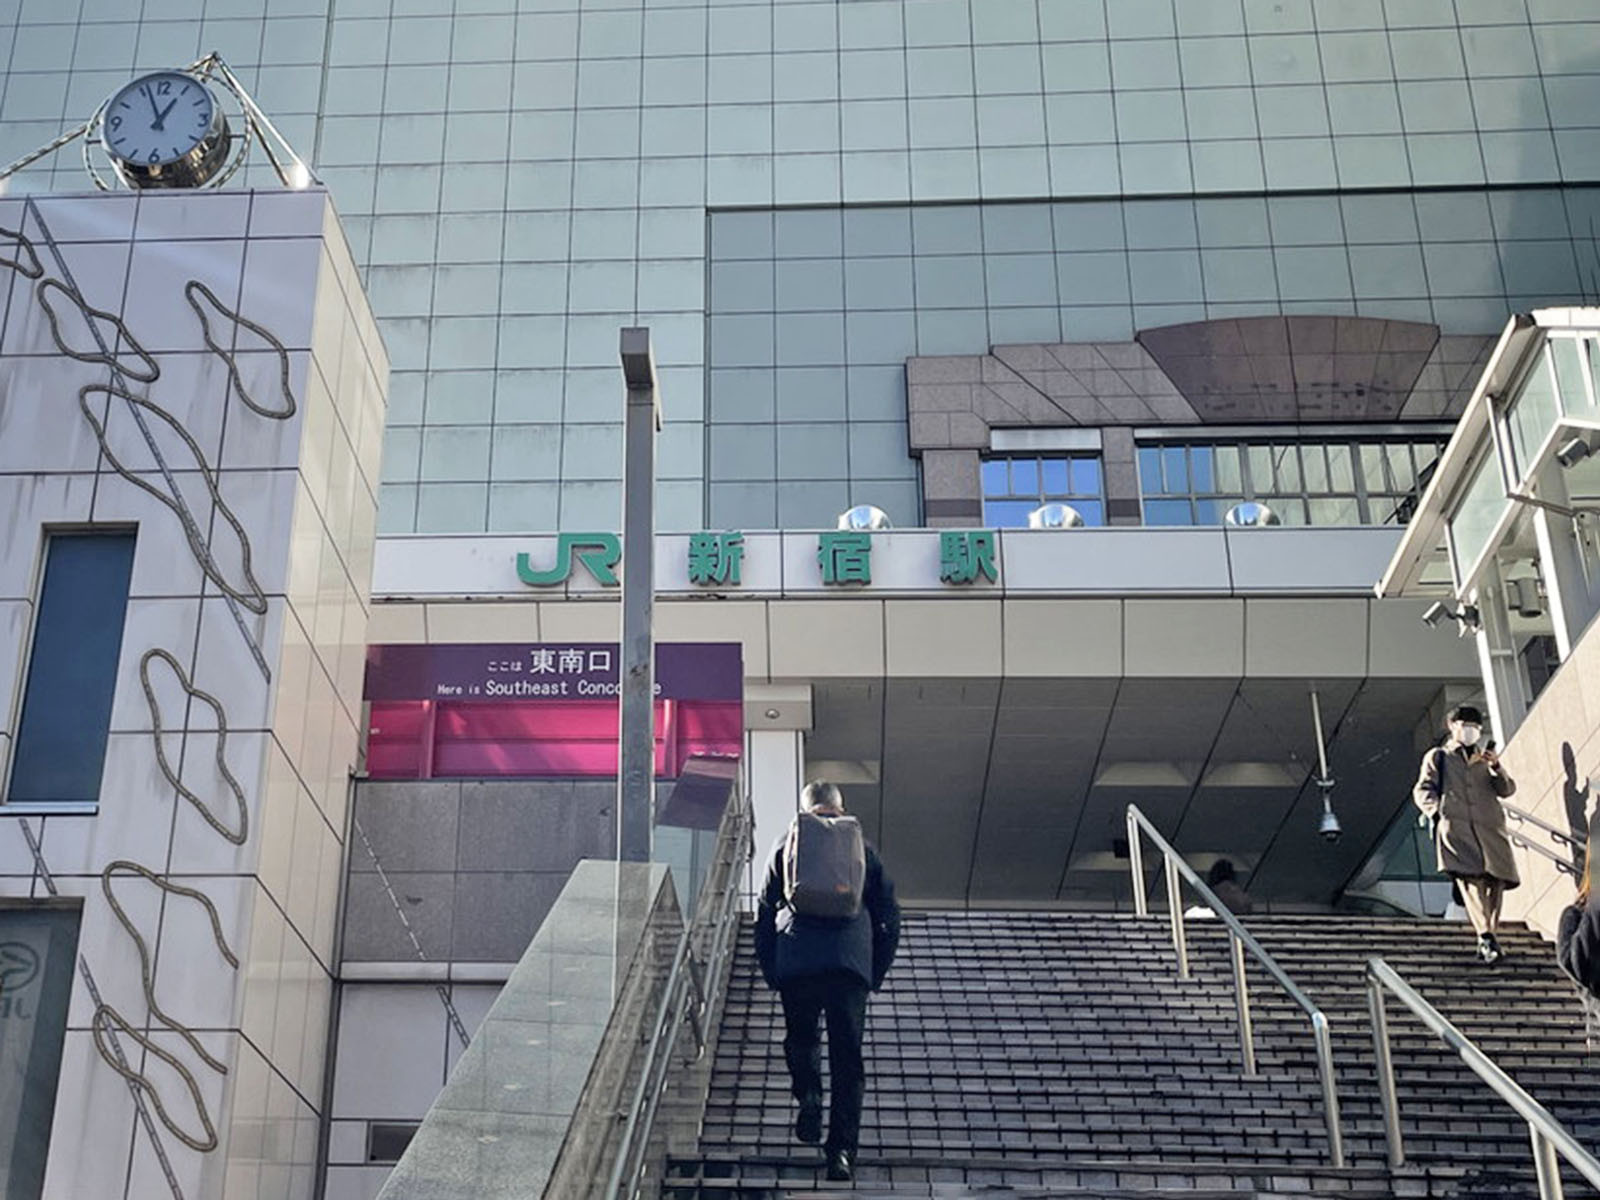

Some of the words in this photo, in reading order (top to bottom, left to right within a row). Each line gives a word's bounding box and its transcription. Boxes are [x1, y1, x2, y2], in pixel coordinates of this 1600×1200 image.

[157, 81, 170, 94] 12
[110, 116, 122, 132] 9
[198, 113, 209, 127] 3
[148, 148, 160, 163] 6
[516, 532, 622, 586] JR
[688, 530, 998, 586] 新宿駅
[487, 661, 522, 672] ここは
[530, 649, 611, 674] 東南口
[437, 684, 463, 695] Here
[469, 684, 480, 695] is
[485, 680, 569, 696] Southeast
[577, 680, 662, 696] Concoe
